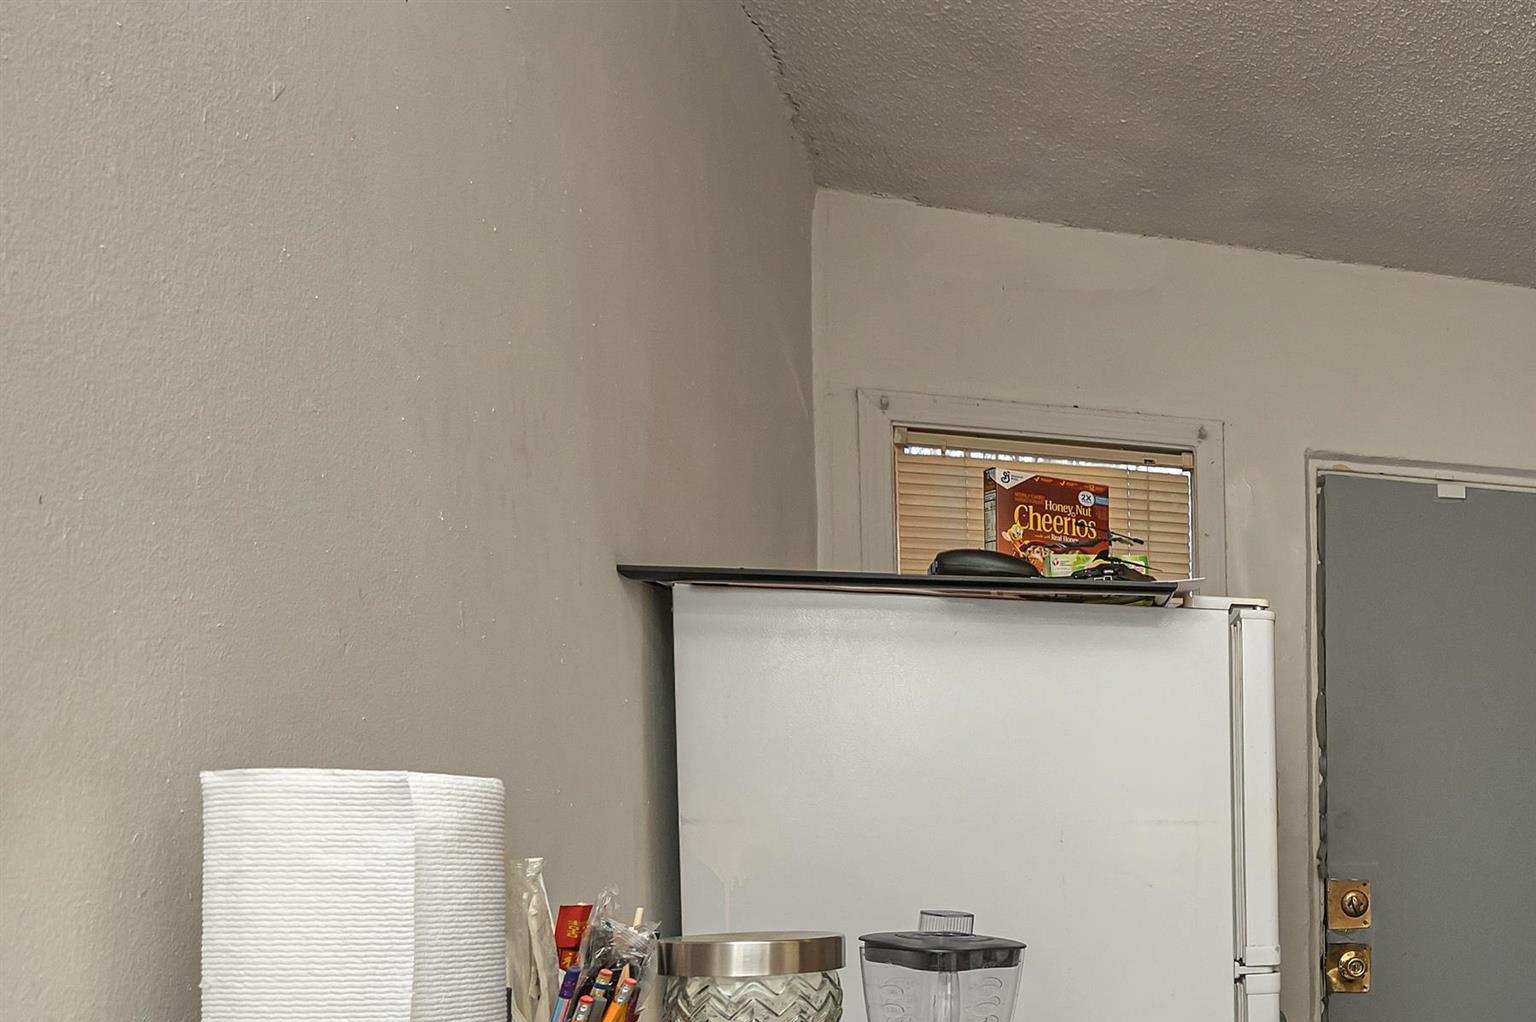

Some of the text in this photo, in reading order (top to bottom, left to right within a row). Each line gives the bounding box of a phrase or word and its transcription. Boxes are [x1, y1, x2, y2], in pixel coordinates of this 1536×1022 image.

[1081, 494, 1092, 502] 2X
[1045, 500, 1092, 517] Honey Nut
[1014, 504, 1097, 539] Cheerios
